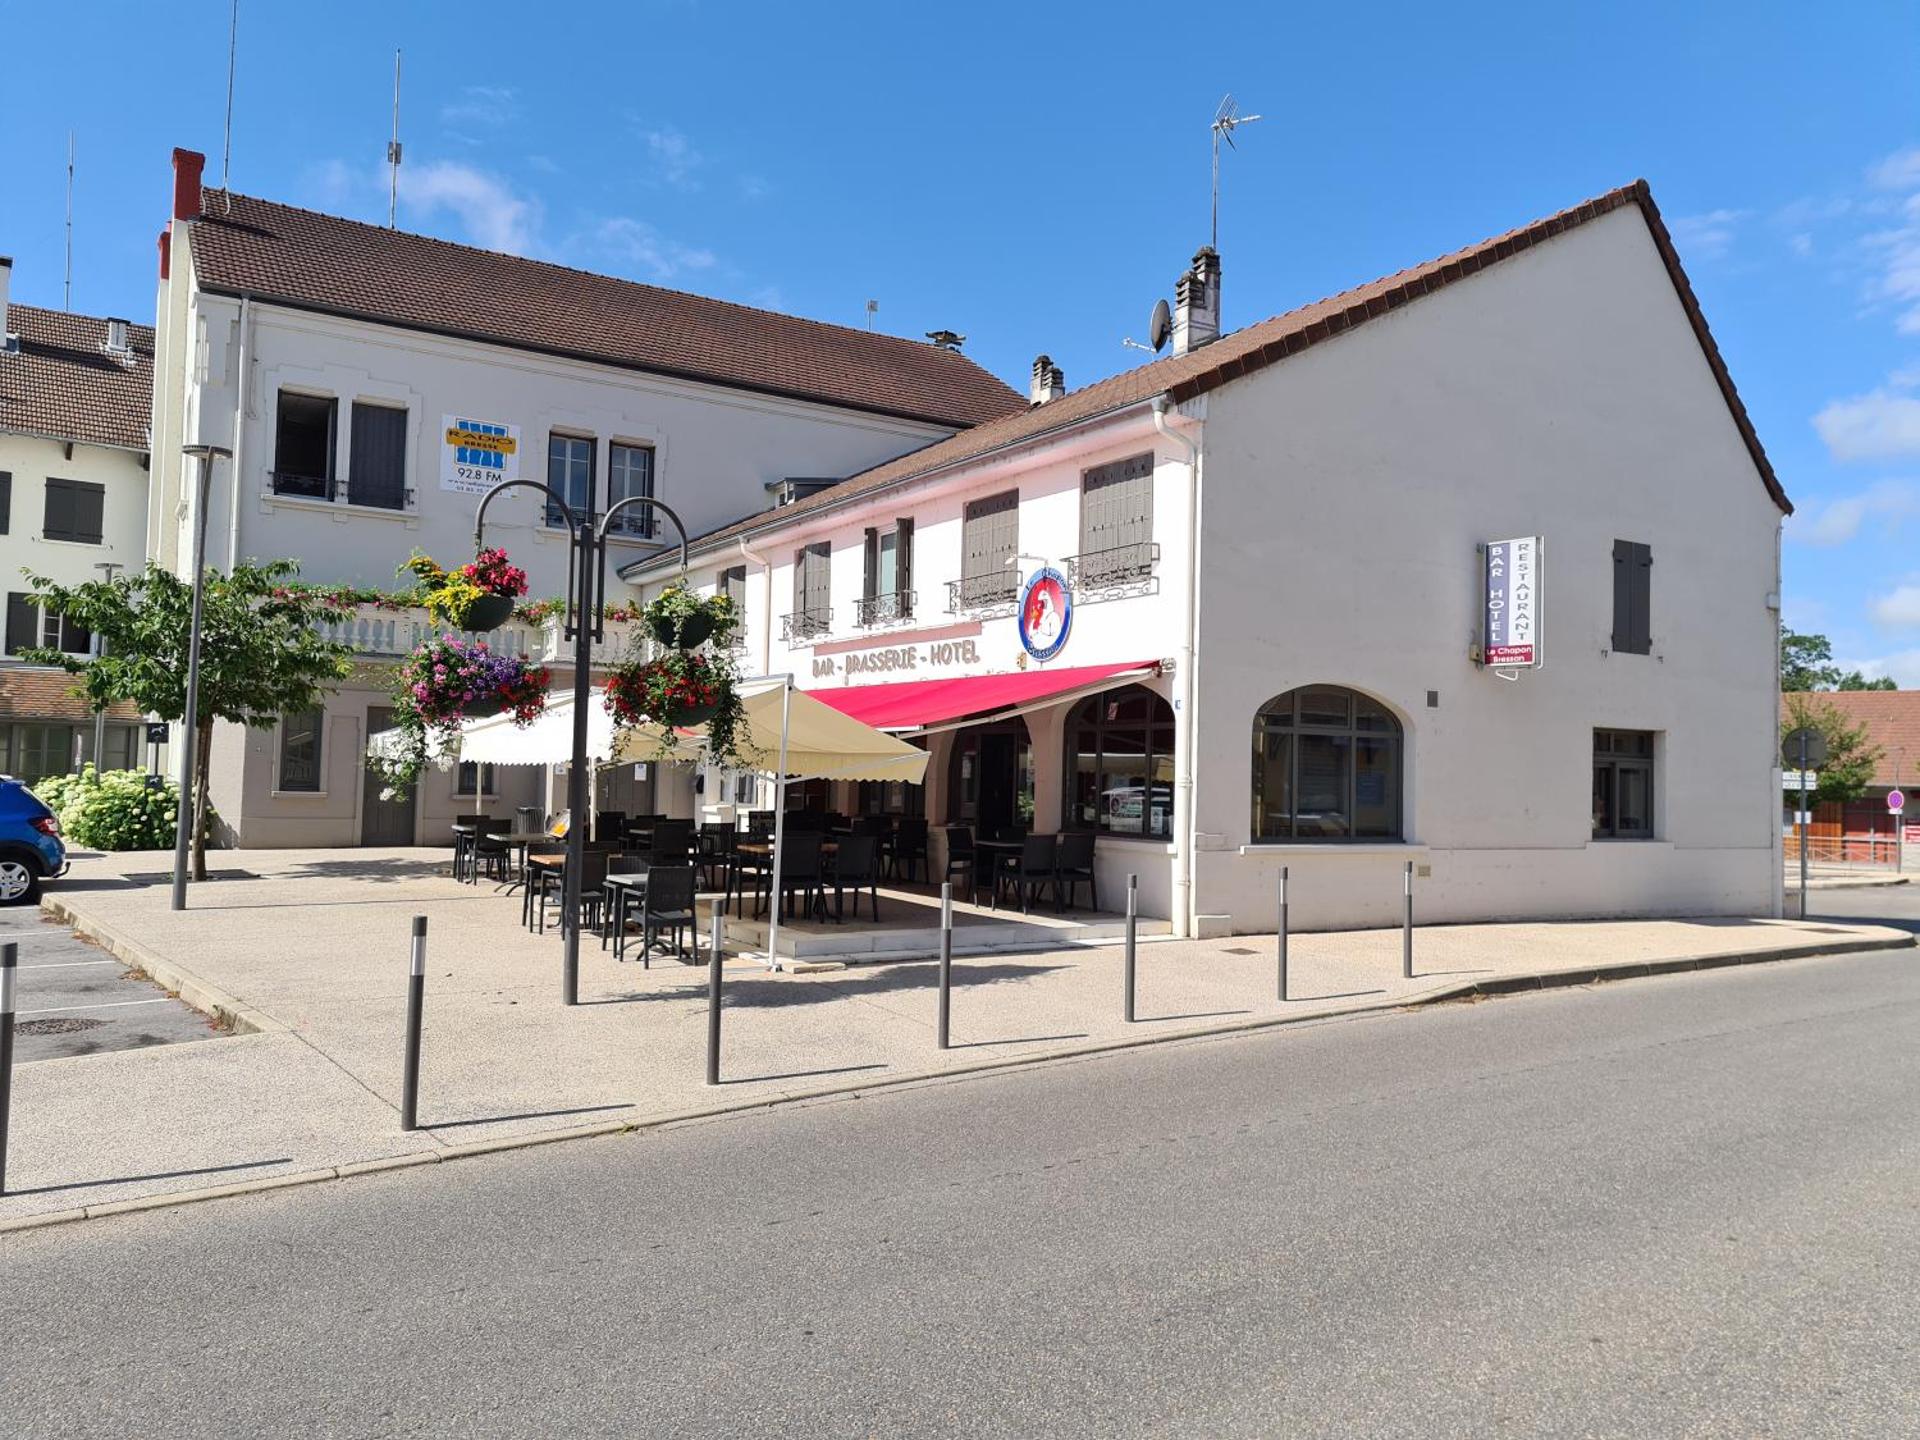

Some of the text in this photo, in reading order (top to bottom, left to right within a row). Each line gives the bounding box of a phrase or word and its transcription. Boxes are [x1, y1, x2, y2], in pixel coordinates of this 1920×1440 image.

[449, 430, 512, 444] RADIO
[457, 467, 503, 482] 92.8 FM
[1488, 546, 1505, 641] BAR HOTEL
[1515, 543, 1530, 641] RESTAURANT
[812, 657, 835, 679] BAR
[845, 645, 918, 676] BRASSERIE
[930, 639, 981, 667] HOTEL
[1497, 646, 1532, 658] Chapon
